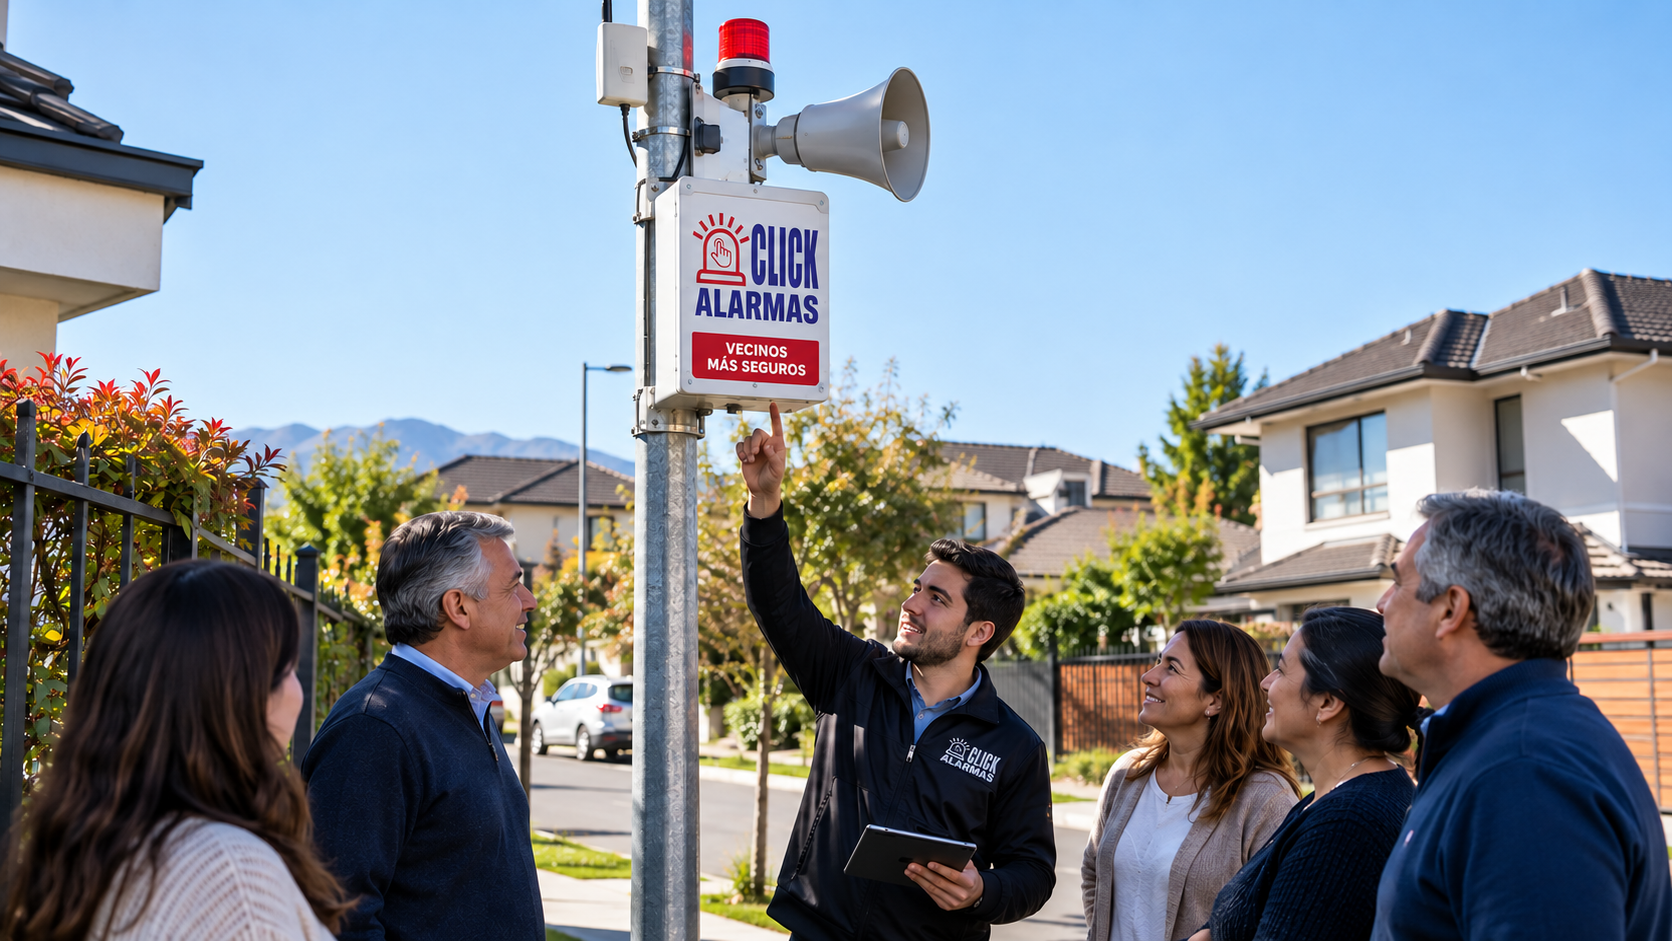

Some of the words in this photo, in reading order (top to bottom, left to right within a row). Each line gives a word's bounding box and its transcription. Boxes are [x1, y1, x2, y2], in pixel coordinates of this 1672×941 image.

[751, 223, 819, 289] CLICK
[695, 287, 819, 324] ALARMAS
[725, 342, 788, 358] VECINOS
[707, 355, 738, 372] MÁS
[741, 360, 806, 376] SEGUROS
[940, 754, 995, 783] ALARMAS
[967, 746, 1001, 775] CLICK
